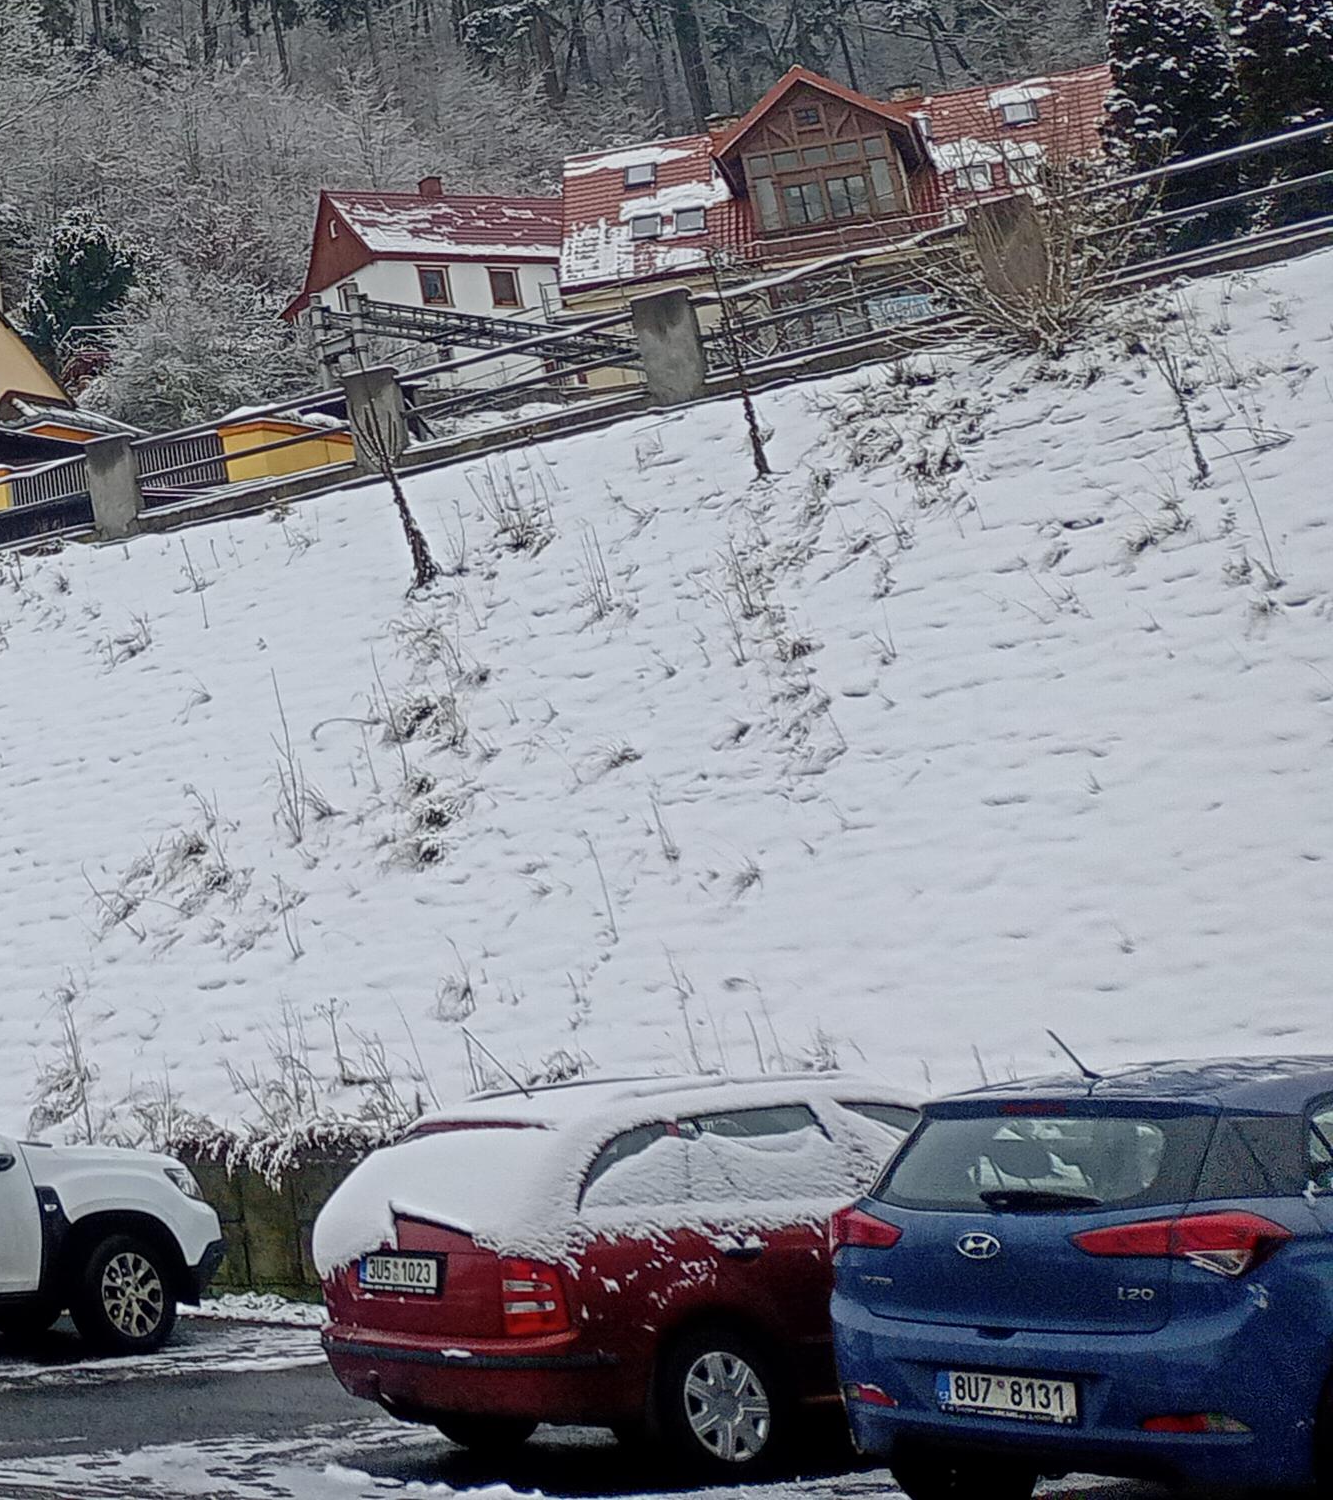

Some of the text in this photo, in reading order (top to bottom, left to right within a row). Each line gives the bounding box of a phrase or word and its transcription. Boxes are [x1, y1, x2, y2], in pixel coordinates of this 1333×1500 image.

[369, 1259, 431, 1283] 3U5 1023
[954, 1375, 991, 1403] 8U7
[1010, 1381, 1064, 1411] 8131
